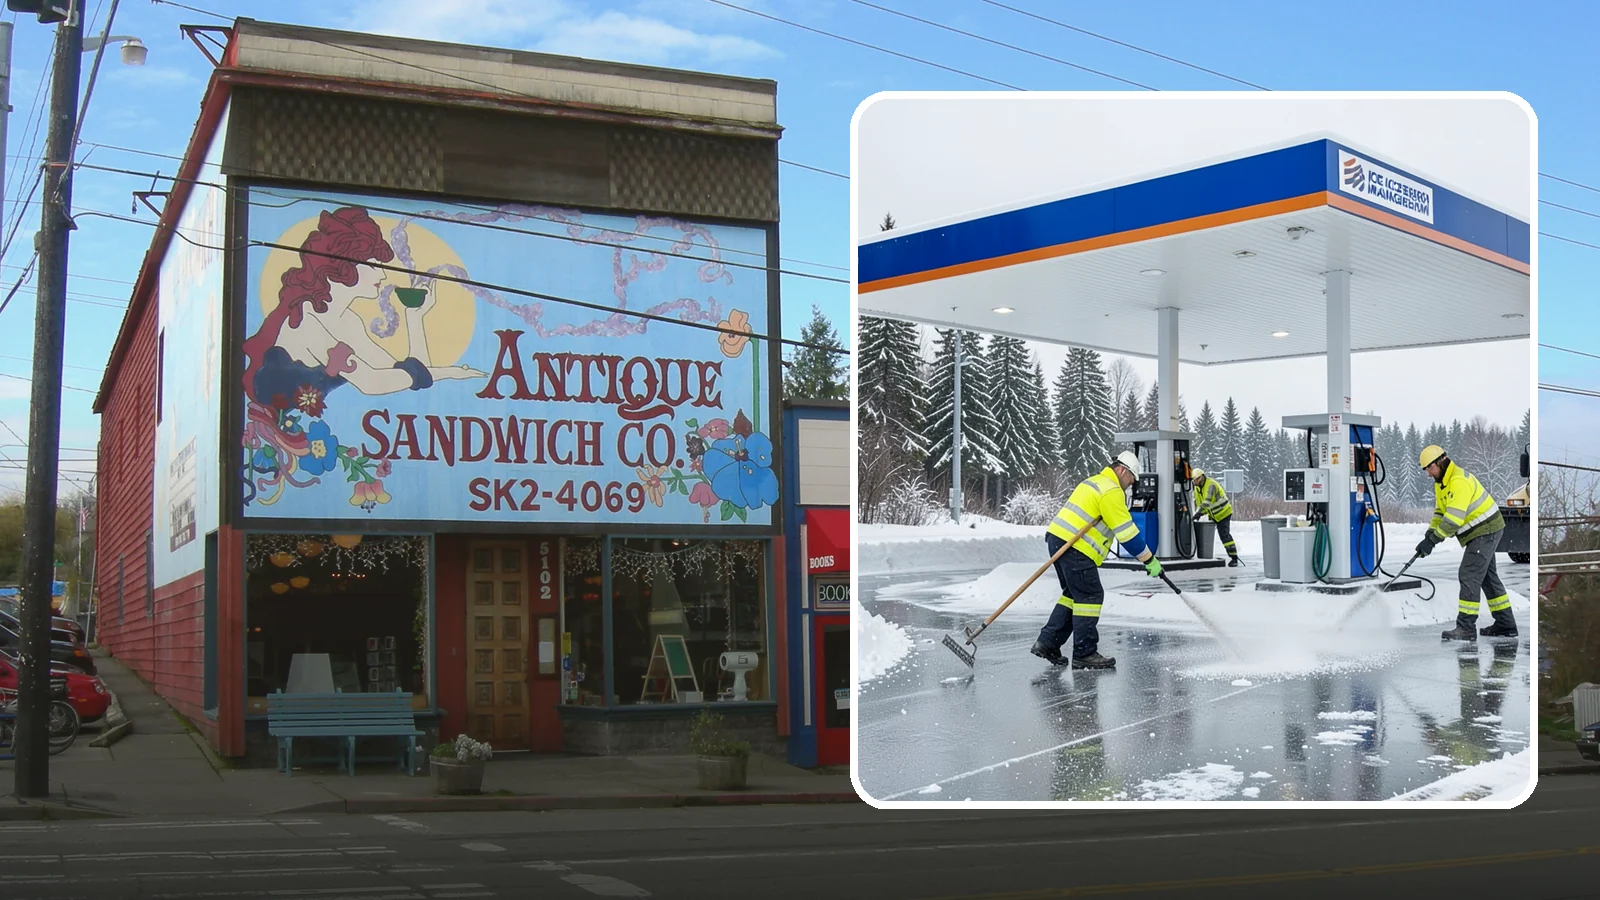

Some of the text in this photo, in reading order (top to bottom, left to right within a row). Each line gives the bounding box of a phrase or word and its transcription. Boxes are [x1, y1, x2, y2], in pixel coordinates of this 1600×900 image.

[475, 328, 724, 420] ANTIQUE
[360, 408, 685, 469] SANDWICH CO.
[468, 477, 646, 513] SK2-4069
[539, 541, 552, 600] 5102
[809, 555, 835, 569] BOOKS
